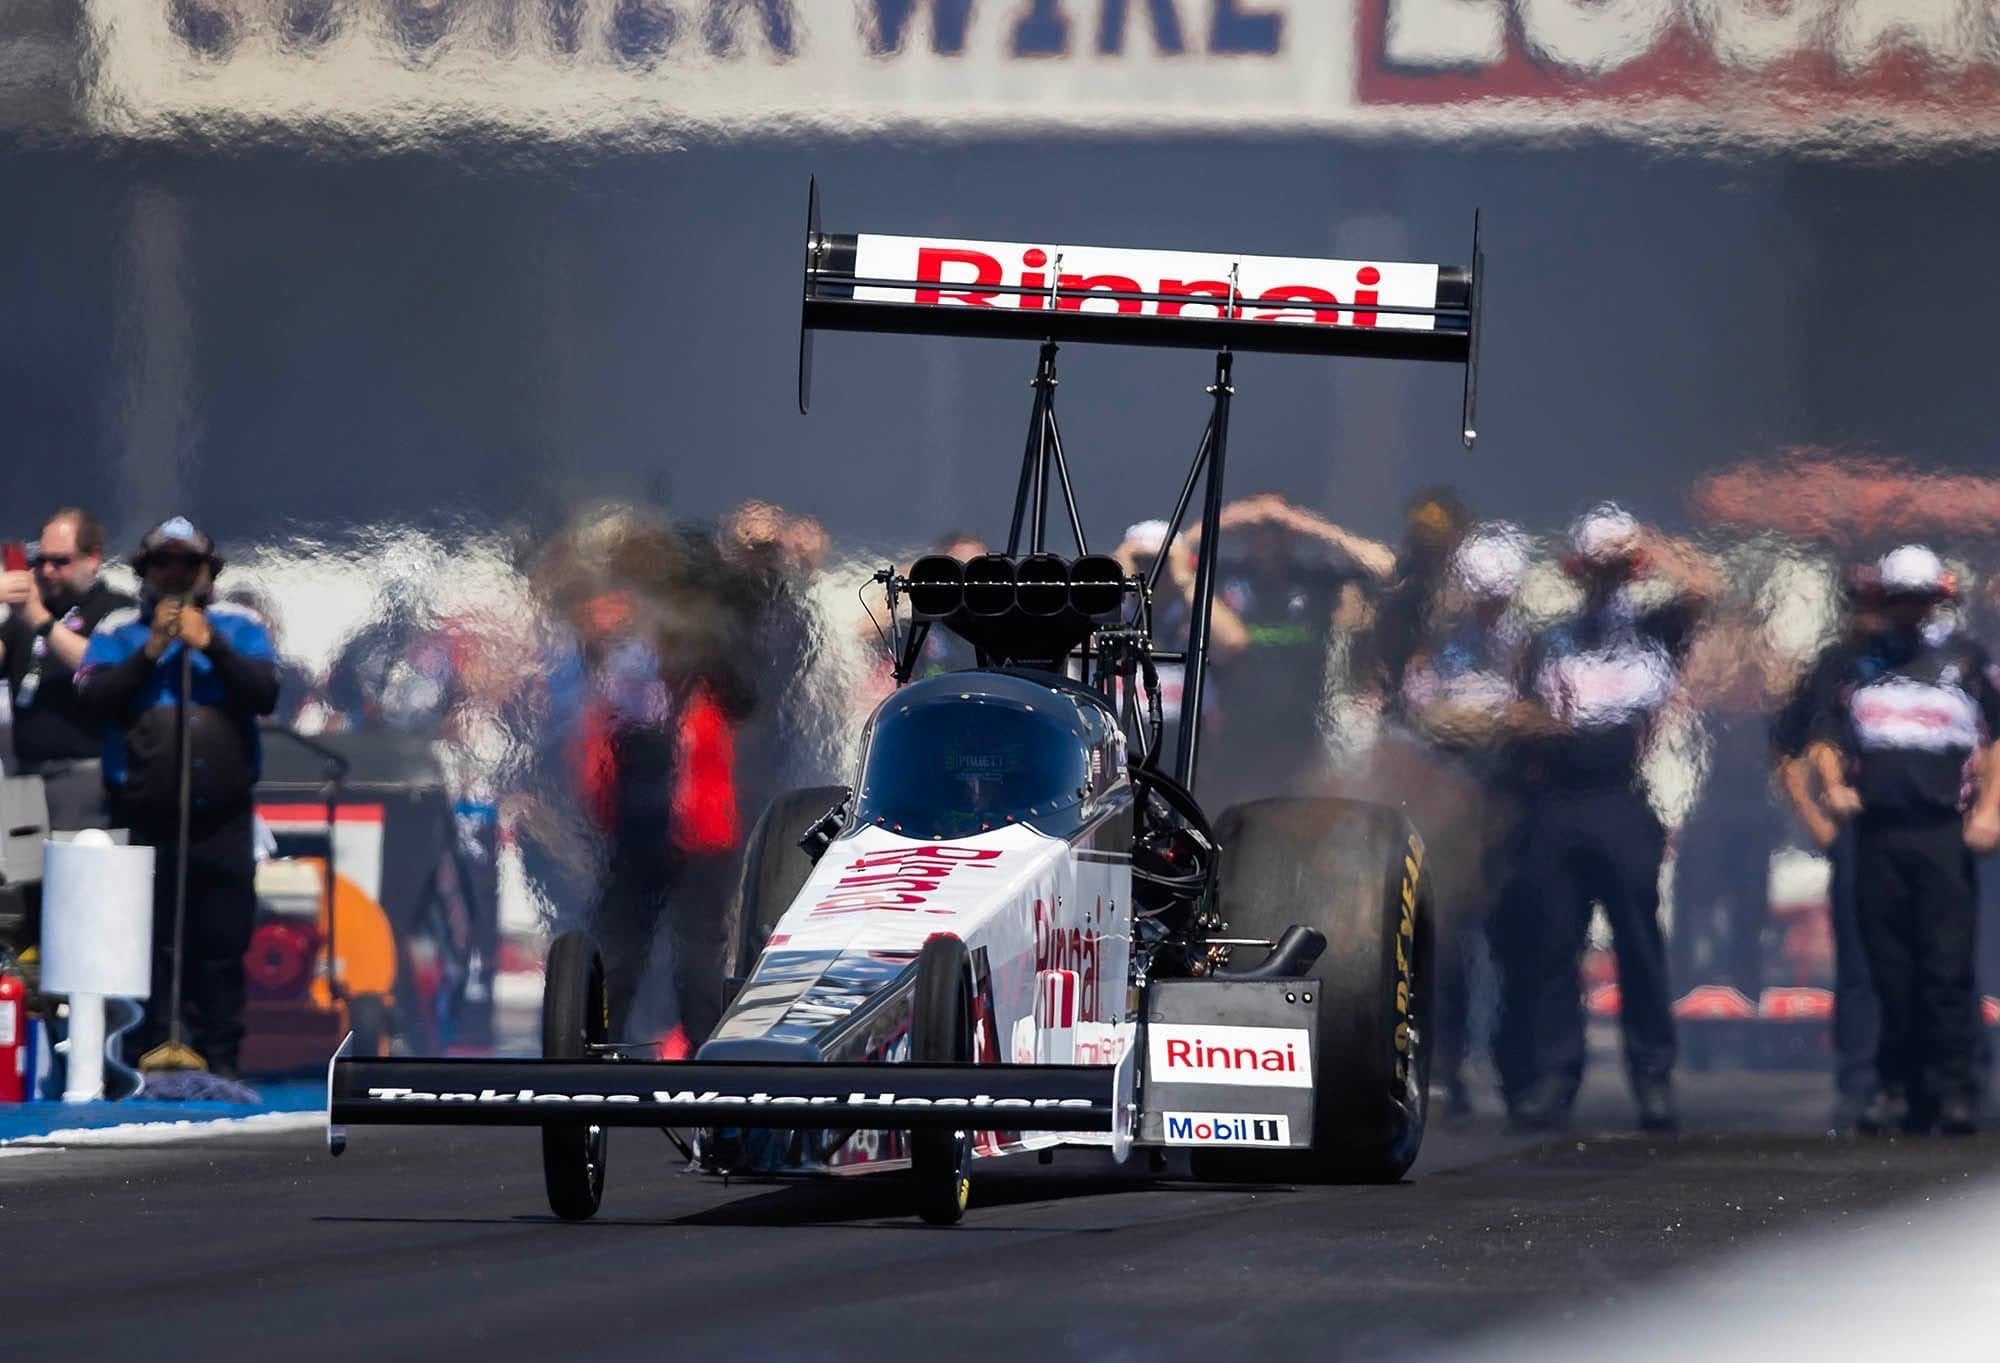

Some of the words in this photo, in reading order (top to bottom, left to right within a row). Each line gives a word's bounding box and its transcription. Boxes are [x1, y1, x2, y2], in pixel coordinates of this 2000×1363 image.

[914, 246, 1382, 328] Rinnai
[1166, 1038, 1297, 1073] Rinnai
[1168, 1117, 1247, 1141] Mobil
[1257, 1119, 1274, 1141] 1
